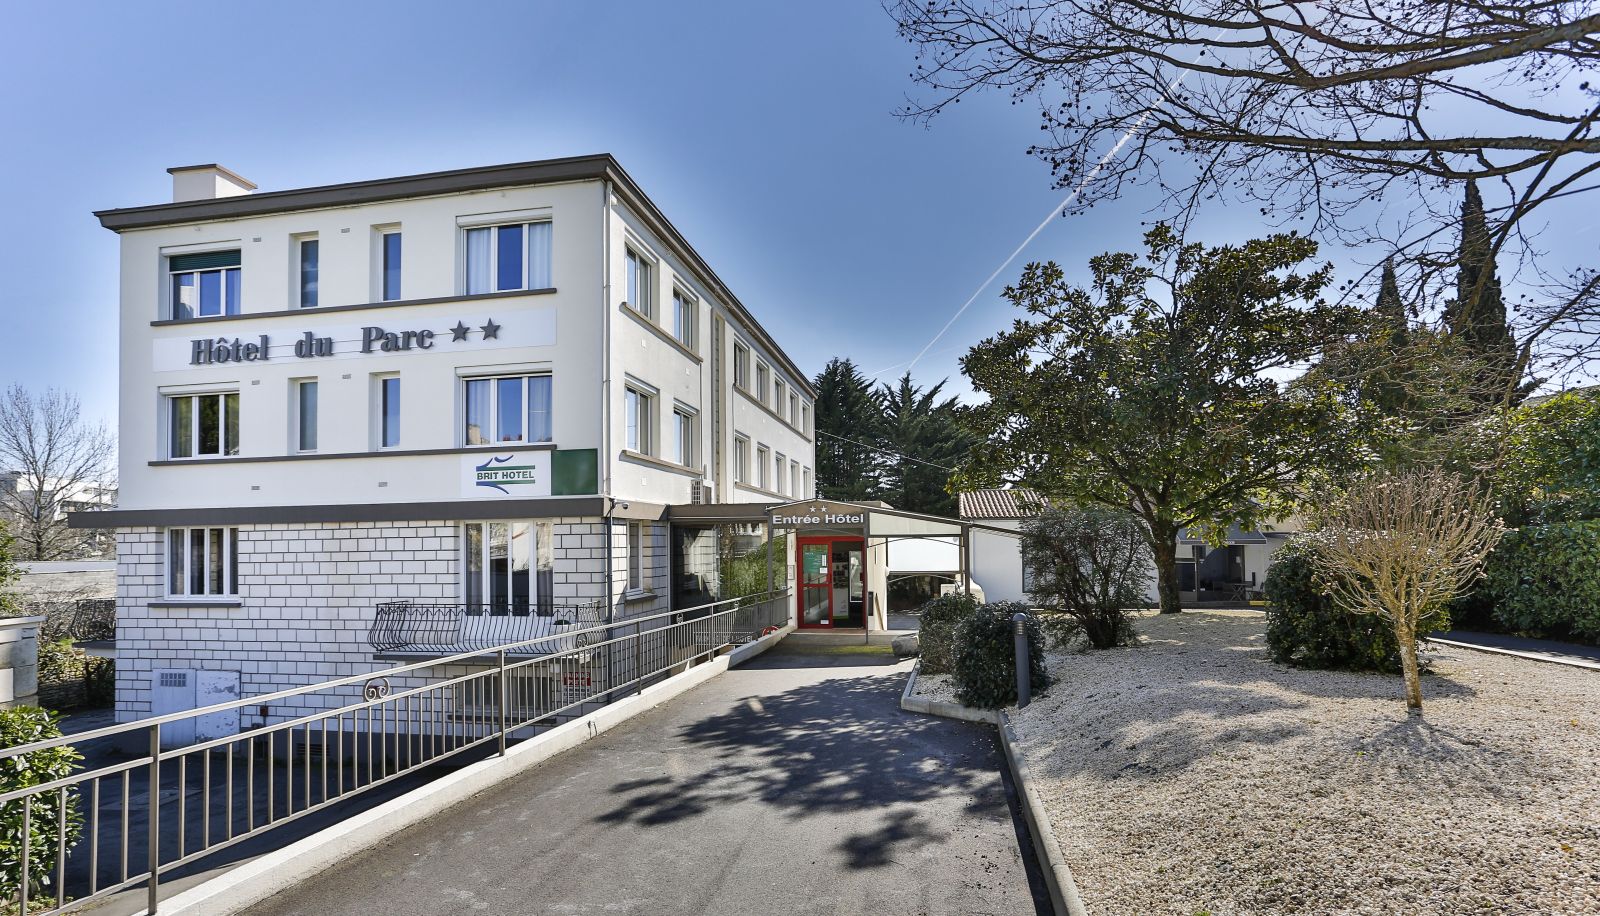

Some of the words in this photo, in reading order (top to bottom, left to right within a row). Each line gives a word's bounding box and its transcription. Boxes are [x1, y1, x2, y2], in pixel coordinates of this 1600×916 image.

[190, 335, 268, 365] Hôtel
[294, 332, 333, 358] du
[360, 326, 434, 353] Parc
[477, 472, 499, 480] BRIT
[501, 471, 534, 479] HOTEL
[772, 515, 820, 524] Entrée
[825, 514, 864, 524] Hôtel
